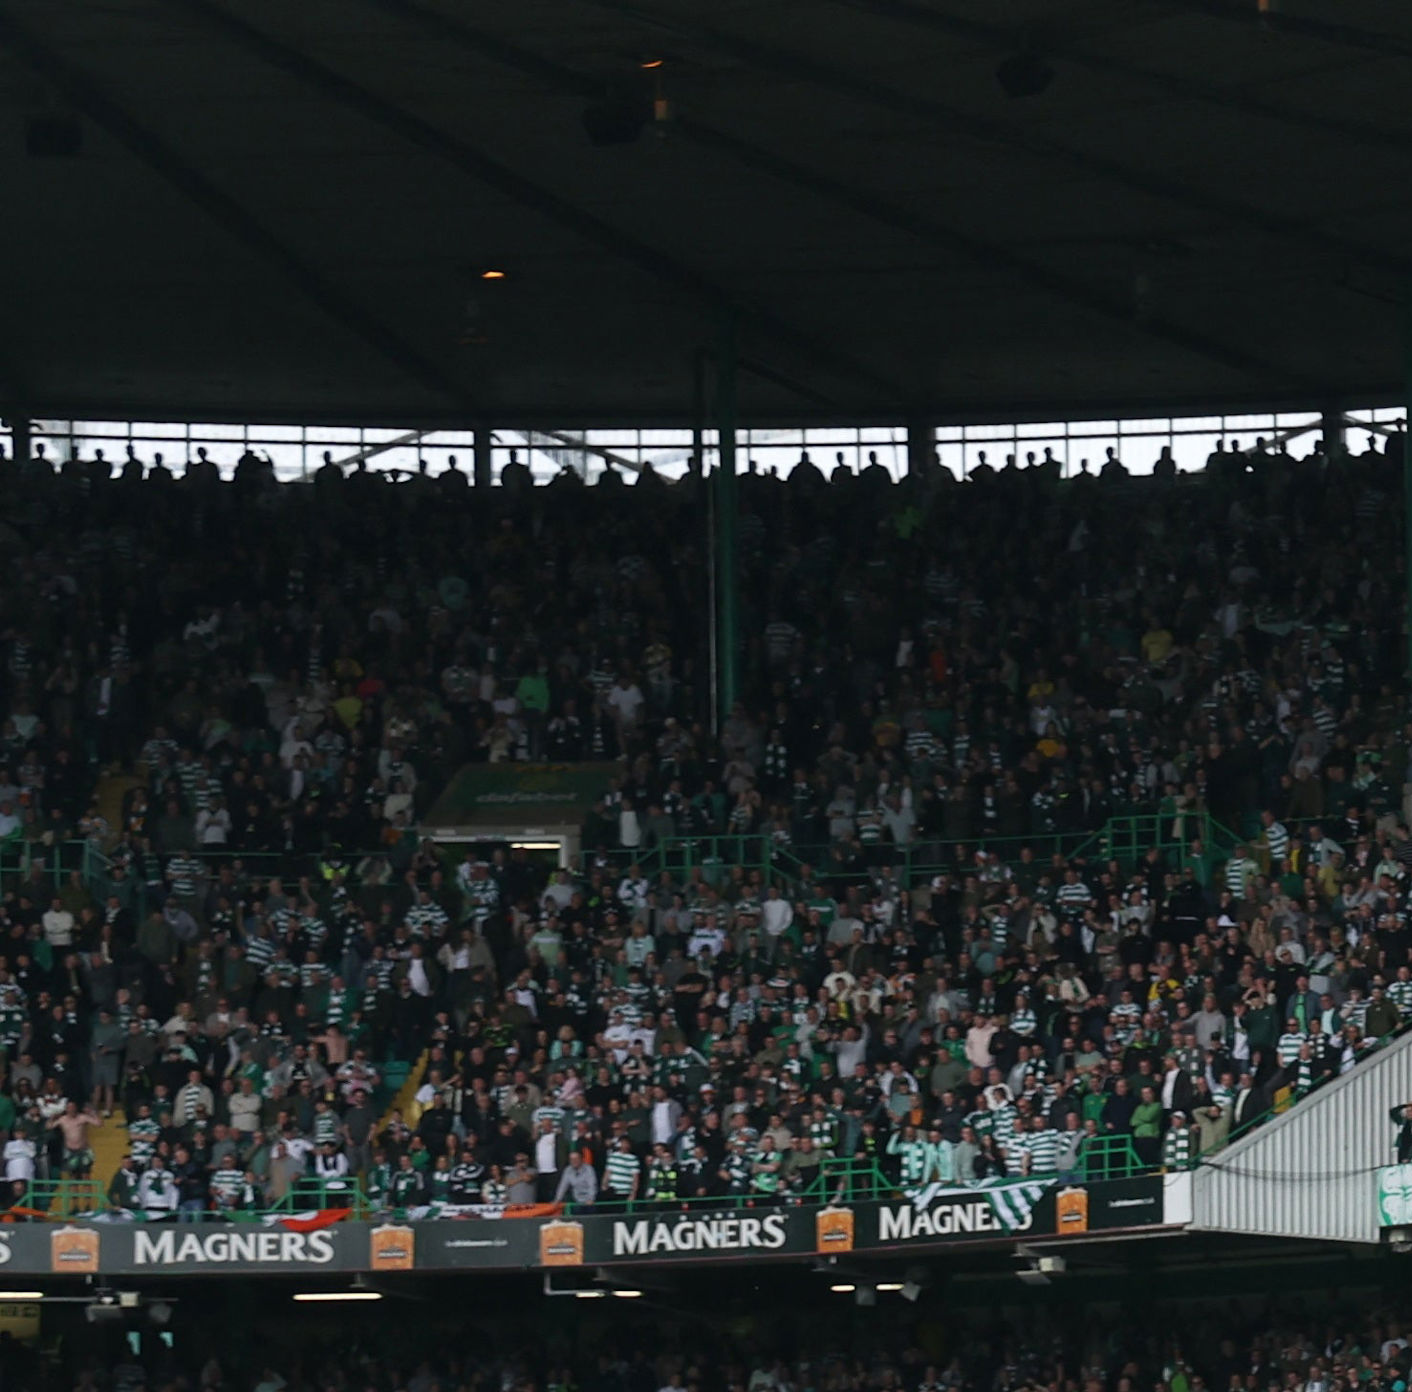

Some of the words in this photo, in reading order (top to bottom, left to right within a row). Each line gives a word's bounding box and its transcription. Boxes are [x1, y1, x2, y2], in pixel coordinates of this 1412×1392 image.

[612, 1219, 786, 1255] MAGNERS
[878, 1201, 1033, 1240] MAGNE
[134, 1229, 334, 1264] MAGNERS
